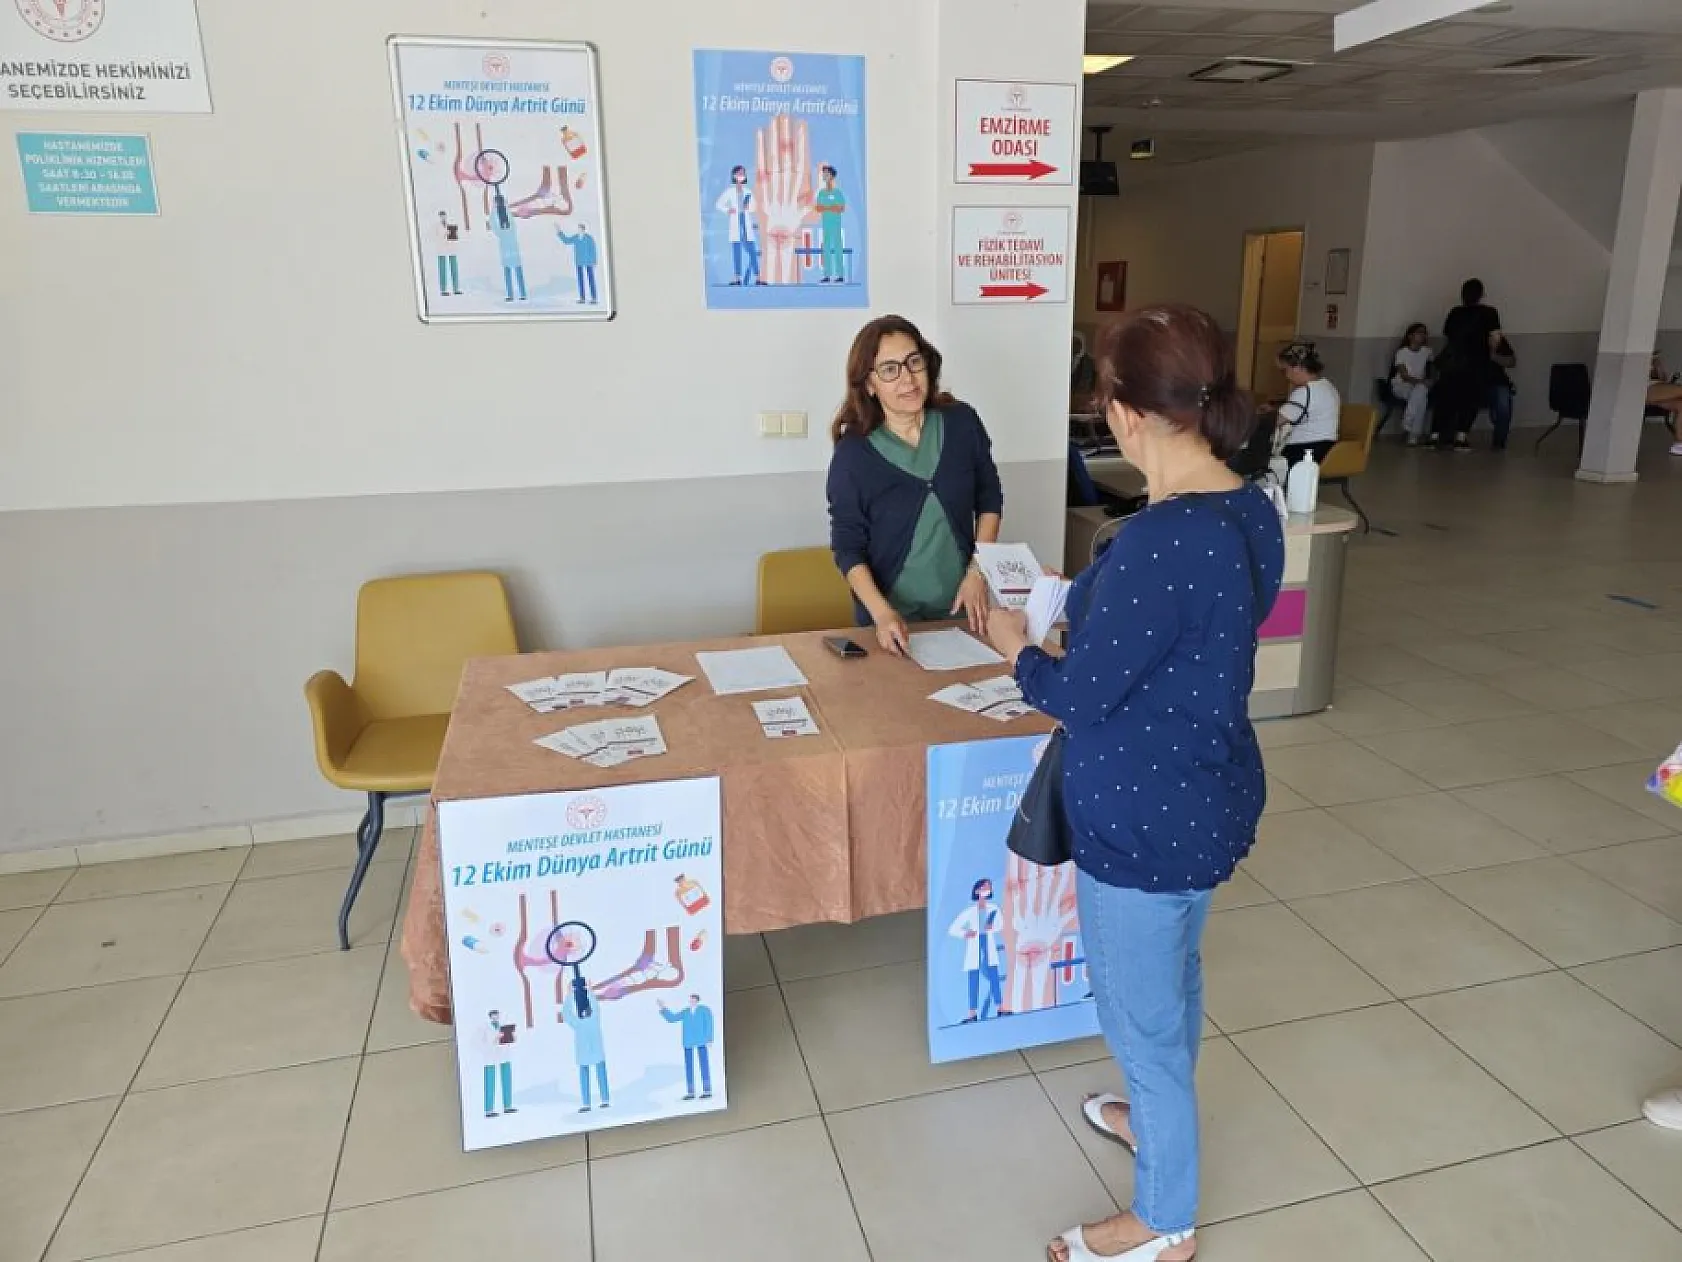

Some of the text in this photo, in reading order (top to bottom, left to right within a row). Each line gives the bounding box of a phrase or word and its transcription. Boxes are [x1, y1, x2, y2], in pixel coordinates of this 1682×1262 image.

[96, 61, 191, 79] HEKİMİNİZİ
[8, 82, 146, 100] SEÇEBİLİRSİNİZ
[409, 94, 586, 116] 12 Ekim Dünya Artrit Günü
[702, 95, 858, 115] 12 Ekim Dünya Artrit Günü
[980, 114, 1051, 136] EMZİRME
[992, 139, 1038, 156] ODASI
[42, 169, 69, 178] SAAT
[978, 237, 1044, 251] FİZİK TEDAVİ
[958, 252, 1063, 266] VE REHABİLİTASYON
[989, 267, 1031, 281] ÜNİTESİ
[937, 798, 958, 820] 12
[960, 794, 1002, 817] Ekim
[507, 822, 662, 853] MENTEŞE DEVLET HASTANESİ
[451, 837, 712, 888] 12 Ekim Dünya Artrit Günü
